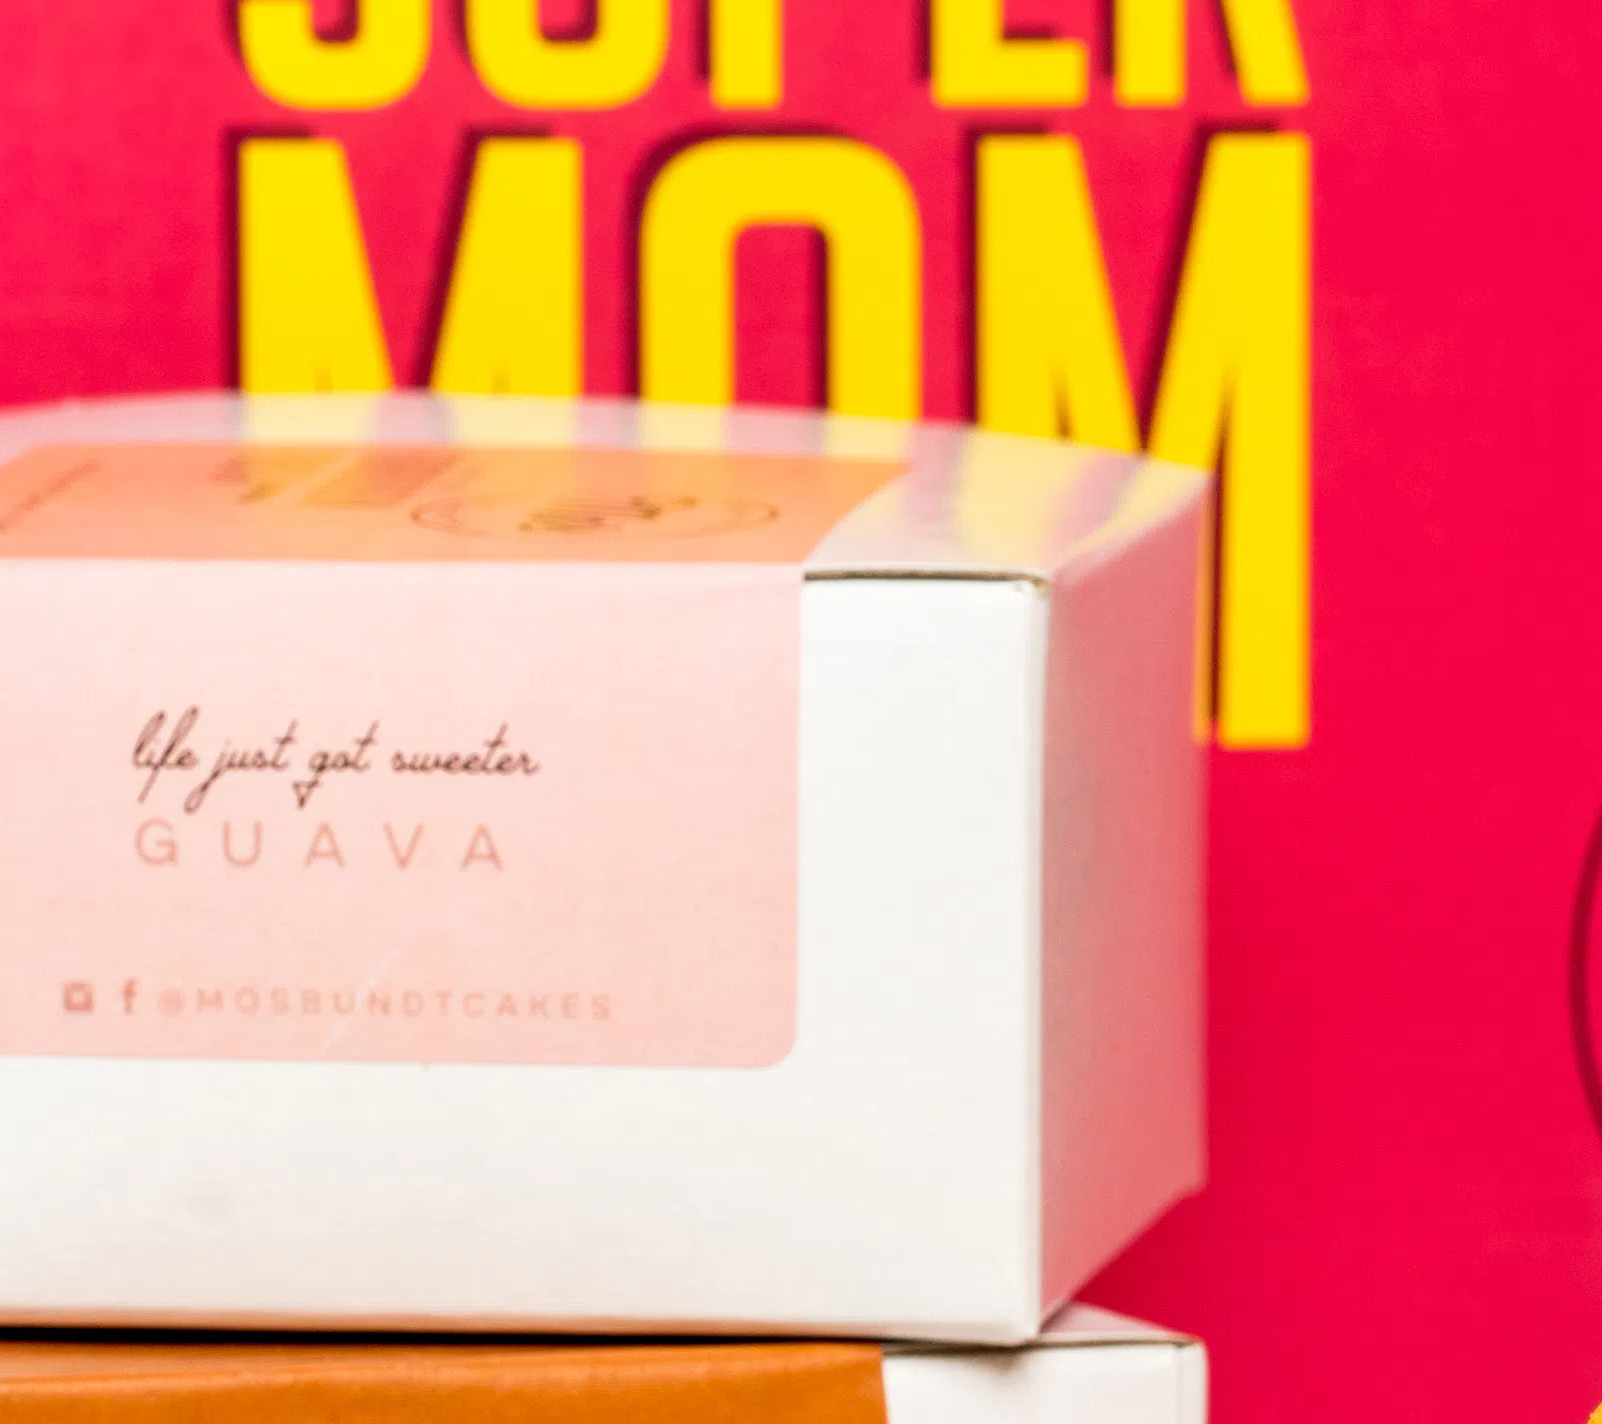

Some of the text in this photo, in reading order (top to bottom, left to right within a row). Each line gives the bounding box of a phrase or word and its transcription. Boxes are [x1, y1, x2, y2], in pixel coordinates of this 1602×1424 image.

[132, 705, 539, 814] life just got sweeter
[134, 817, 504, 871] GUAVA
